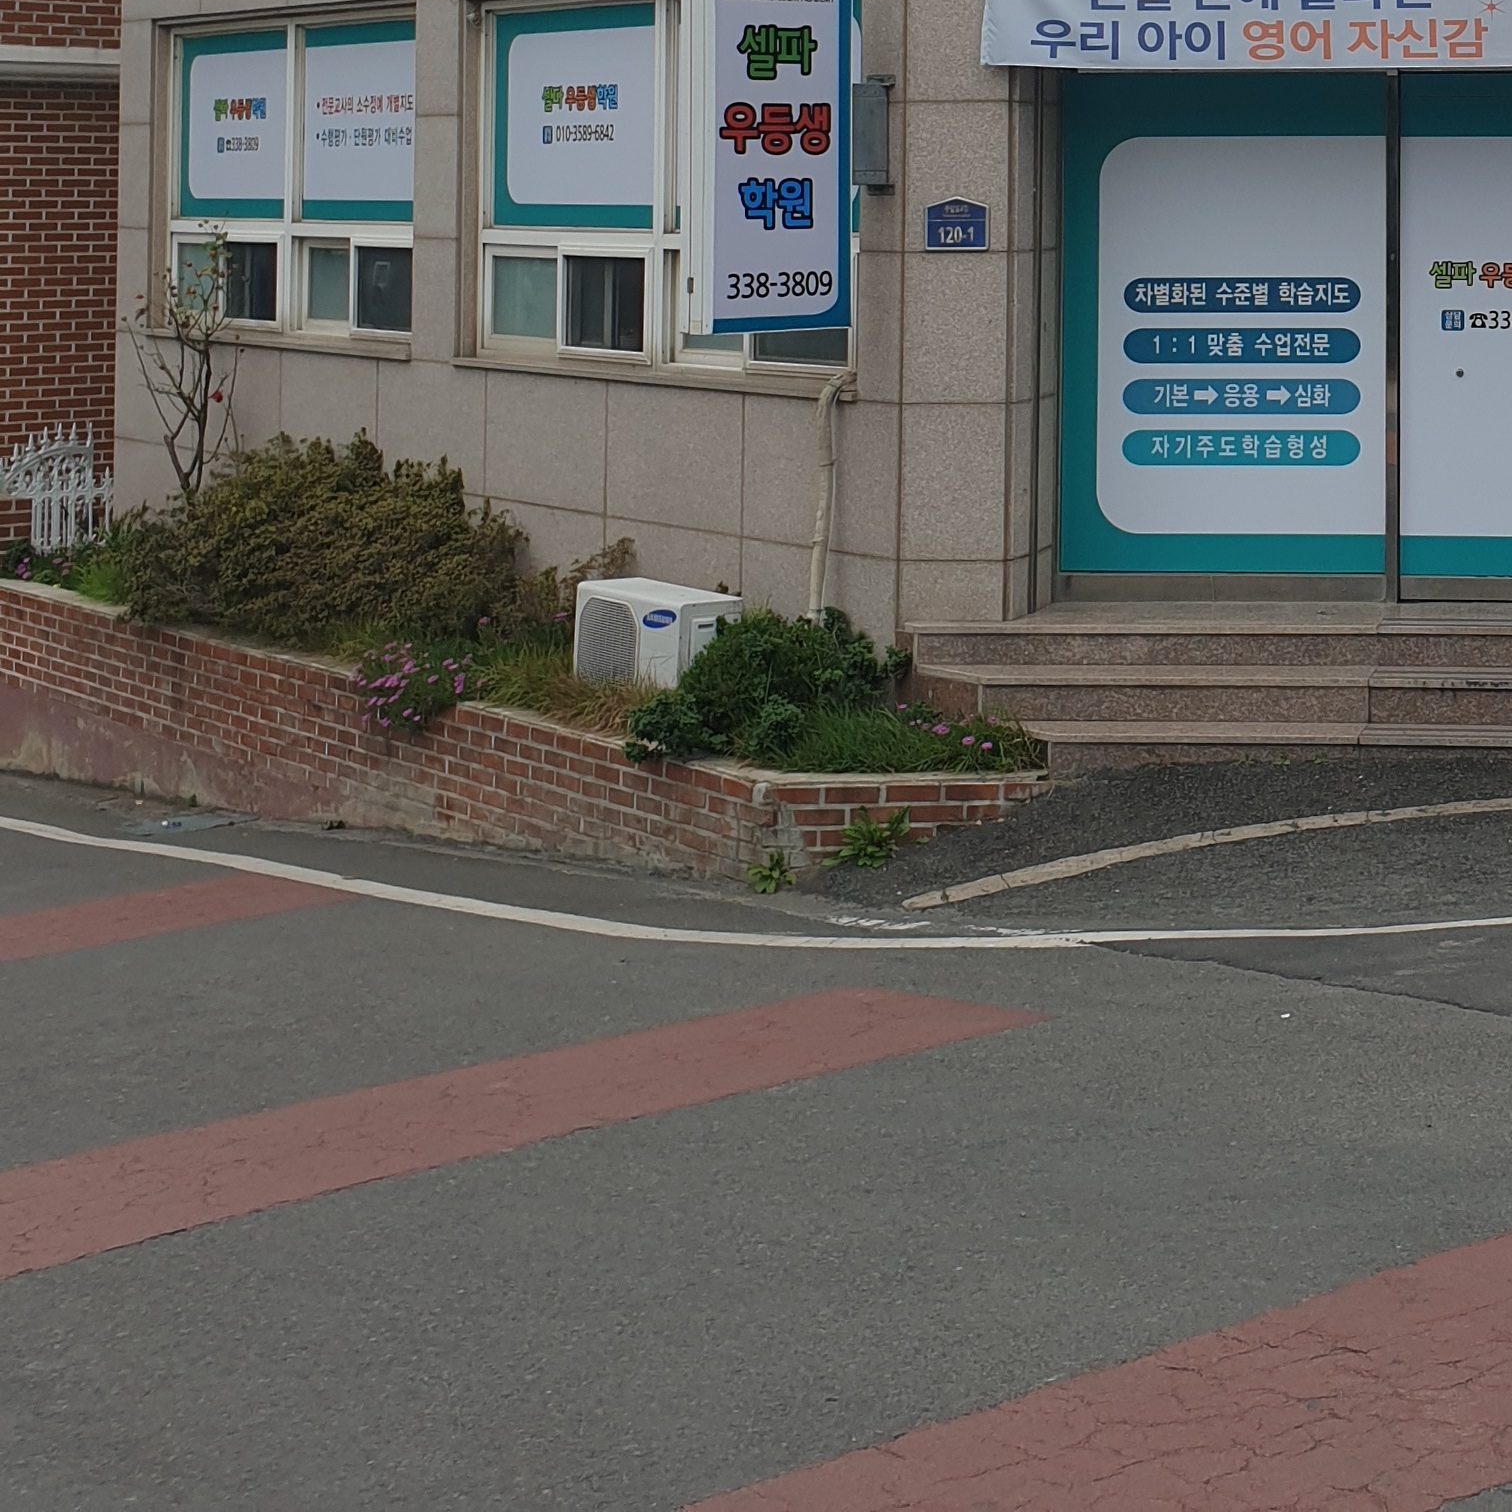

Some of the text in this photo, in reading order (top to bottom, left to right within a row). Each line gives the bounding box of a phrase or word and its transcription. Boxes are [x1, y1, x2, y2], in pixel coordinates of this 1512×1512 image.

[1030, 18, 1488, 61] 우리 아이 영어 자신감
[737, 25, 818, 80] 셀파
[322, 97, 353, 115] 전문교사의
[386, 93, 414, 113] 개별지도
[556, 124, 614, 142] 010-3589-6842
[720, 102, 831, 155] 우등생
[738, 177, 814, 230] 학원
[938, 226, 974, 243] 120-1
[726, 270, 833, 299] 338-3809
[1429, 261, 1476, 289] 셀파
[1134, 282, 1350, 306] 차별화된 수준별 학습지도
[1207, 333, 1244, 356] 맞춤
[1254, 333, 1331, 356] 수업전문
[1153, 384, 1331, 407] 기본 응용 심화
[1151, 435, 1328, 459] 자기주도학습형성
